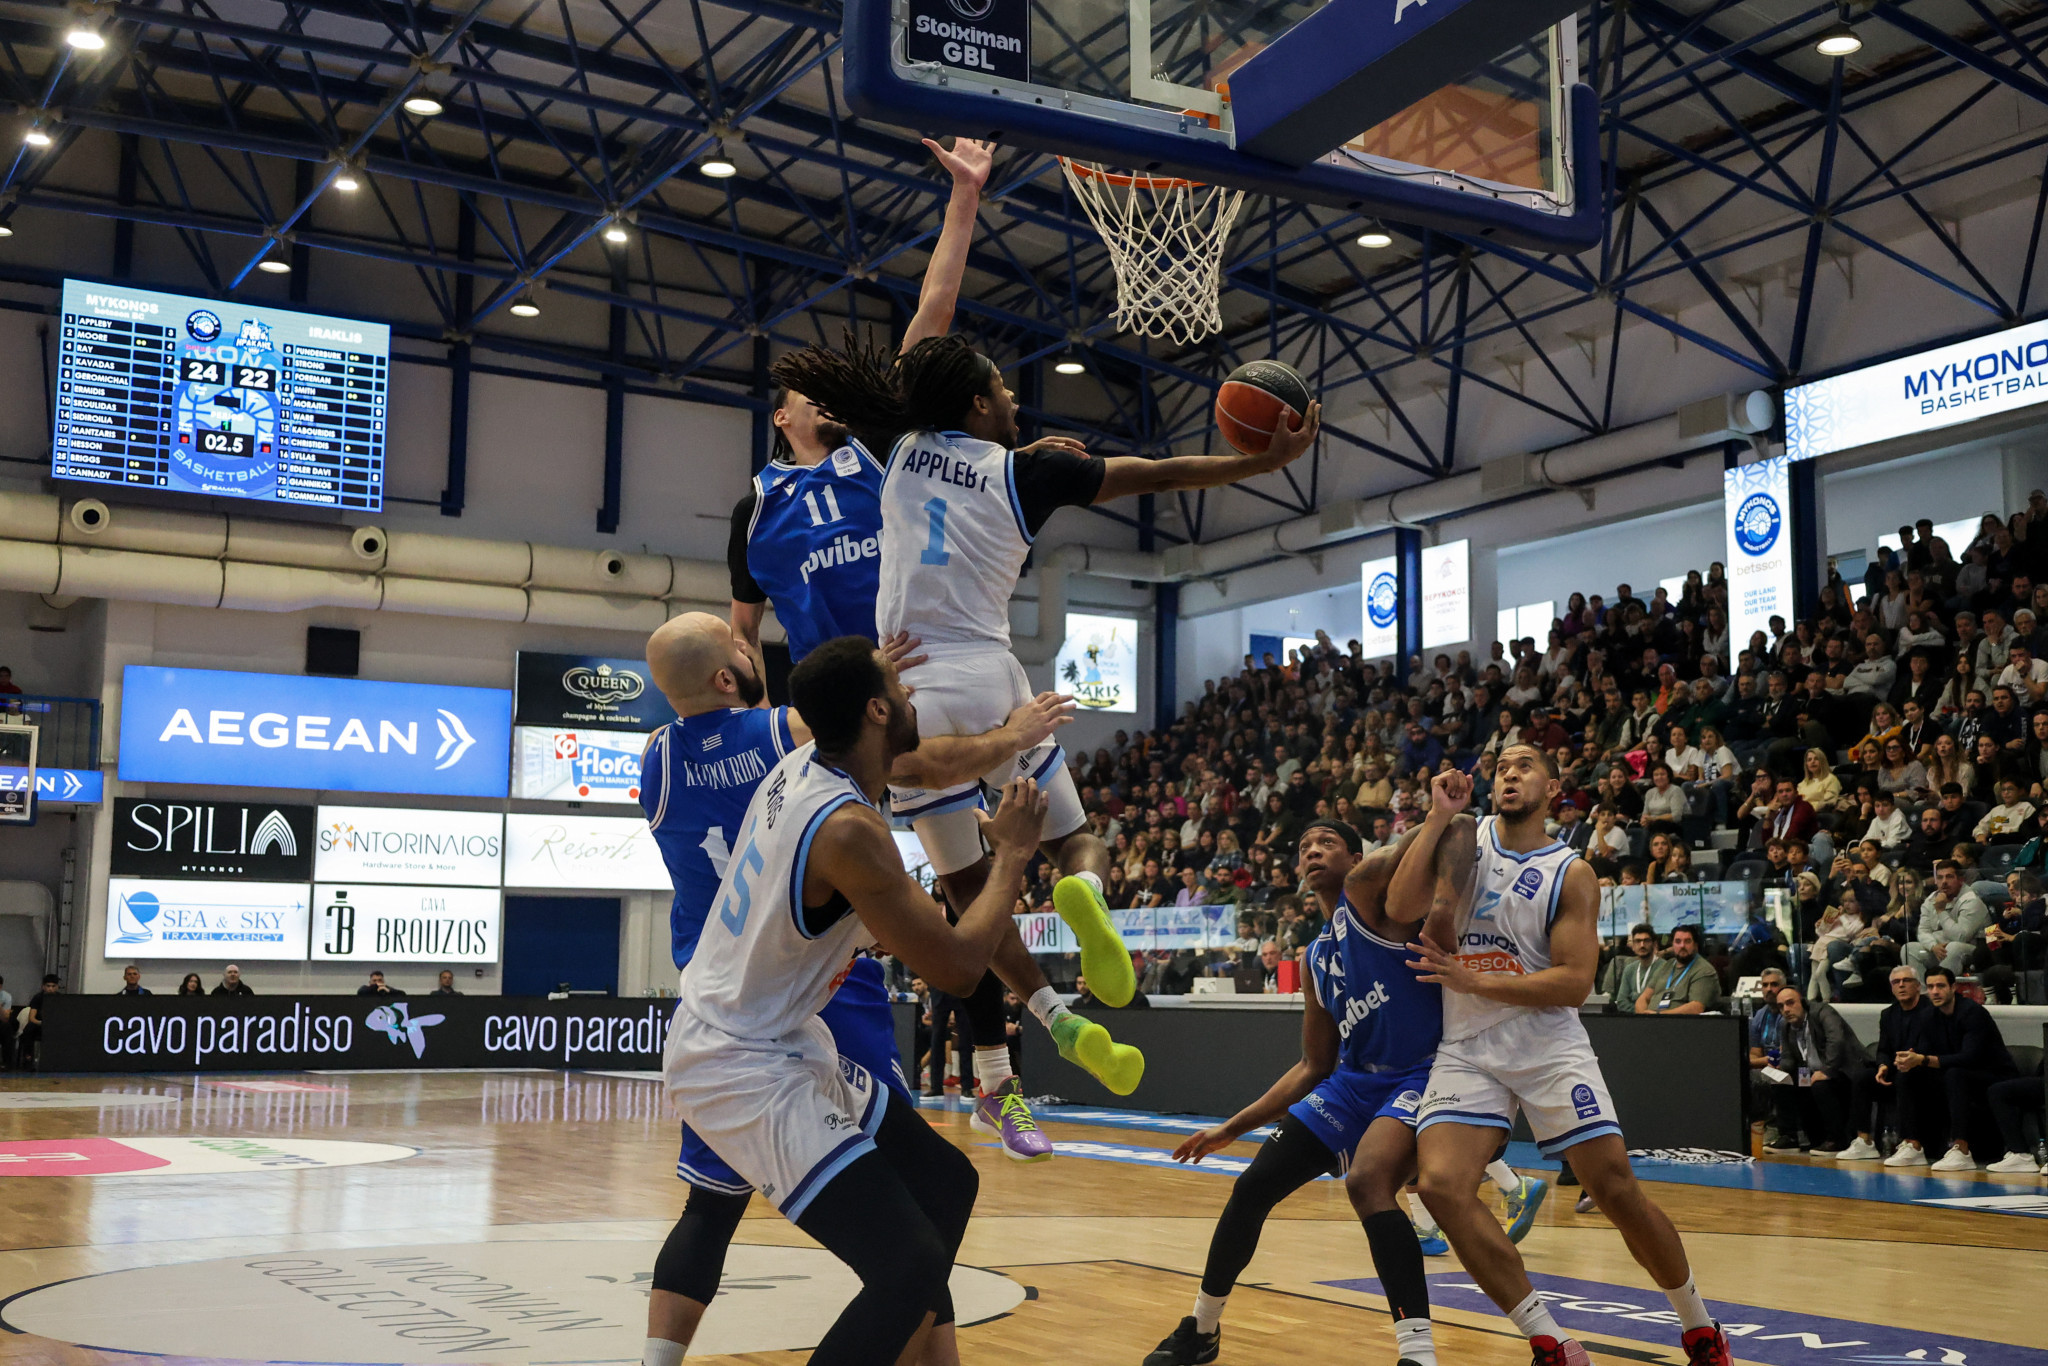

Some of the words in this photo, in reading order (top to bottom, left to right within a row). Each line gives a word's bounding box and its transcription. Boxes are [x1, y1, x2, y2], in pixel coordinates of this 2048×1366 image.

[916, 15, 1021, 53] Stoiximan
[943, 41, 995, 71] GBL
[86, 294, 159, 314] MYKONOS
[79, 317, 112, 328] APPLEBY
[168, 329, 173, 337] 3
[66, 329, 72, 337] 2
[78, 331, 108, 342] MOORE
[309, 326, 362, 344] IRAKLIS
[66, 342, 72, 350] 4
[76, 344, 93, 353] RAY
[296, 347, 342, 360] FUNDERBURK
[76, 358, 115, 370] KAVADAS
[188, 361, 219, 382] 24
[295, 360, 326, 370] STRONG
[74, 372, 129, 385] GEROMICHAL
[239, 368, 269, 388] 22
[294, 372, 332, 384] FOREMAN
[64, 383, 69, 391] 9
[74, 386, 106, 396] ERMIDIS
[294, 386, 316, 396] SMITH
[61, 396, 70, 405] 10
[73, 399, 117, 411] SKOULIDAS
[282, 397, 290, 406] 10
[60, 410, 70, 419] 14
[162, 422, 168, 430] 2
[292, 412, 314, 422] WARE
[59, 424, 68, 432] 17
[71, 426, 116, 438] MANTZARIS
[58, 438, 68, 446] 22
[70, 440, 102, 450] HESSON
[204, 434, 244, 453] 02.5
[280, 437, 288, 445] 14
[70, 454, 100, 464] BRIGGS
[290, 452, 316, 462] SYLLAS
[173, 448, 276, 482] BASKETBALL
[290, 464, 311, 474] EDLER
[312, 467, 332, 476] DAVI
[56, 466, 66, 474] 30
[68, 468, 110, 480] CANNADY
[802, 484, 846, 528] 11
[1738, 496, 1777, 523] MYKONOS
[921, 497, 949, 566] 1
[1736, 558, 1782, 576] betsson
[1744, 590, 1757, 598] OUR
[1758, 586, 1776, 596] LAND
[1744, 598, 1757, 607] OUR
[1758, 595, 1776, 605] TEAM
[1744, 608, 1758, 616] OUR
[1760, 604, 1776, 612] TIME
[578, 675, 630, 691] QUEEN
[562, 711, 597, 722] champagne
[606, 714, 629, 723] cocktail
[158, 708, 418, 755] AEGEAN
[576, 746, 642, 776] flora
[582, 775, 604, 783] SUPER
[606, 776, 638, 785] MARKETS
[530, 825, 650, 882] Resorts
[182, 865, 244, 873] MYKONOS
[362, 861, 402, 869] Hardware
[405, 862, 426, 870] Store
[421, 897, 446, 912] CAVA
[162, 910, 207, 928] SEA
[216, 915, 228, 928] &
[240, 911, 286, 930] SKY
[165, 932, 219, 940] TRAVEL
[221, 932, 281, 942] AGENCY
[376, 918, 487, 956] BROUZOS
[1457, 956, 1518, 971] tsson
[103, 1015, 187, 1055] cavo
[195, 1002, 353, 1065] paradiso
[484, 1015, 557, 1052] cavo
[355, 1256, 623, 1332] MYCONIAN
[244, 1259, 530, 1355] COLLECTION
